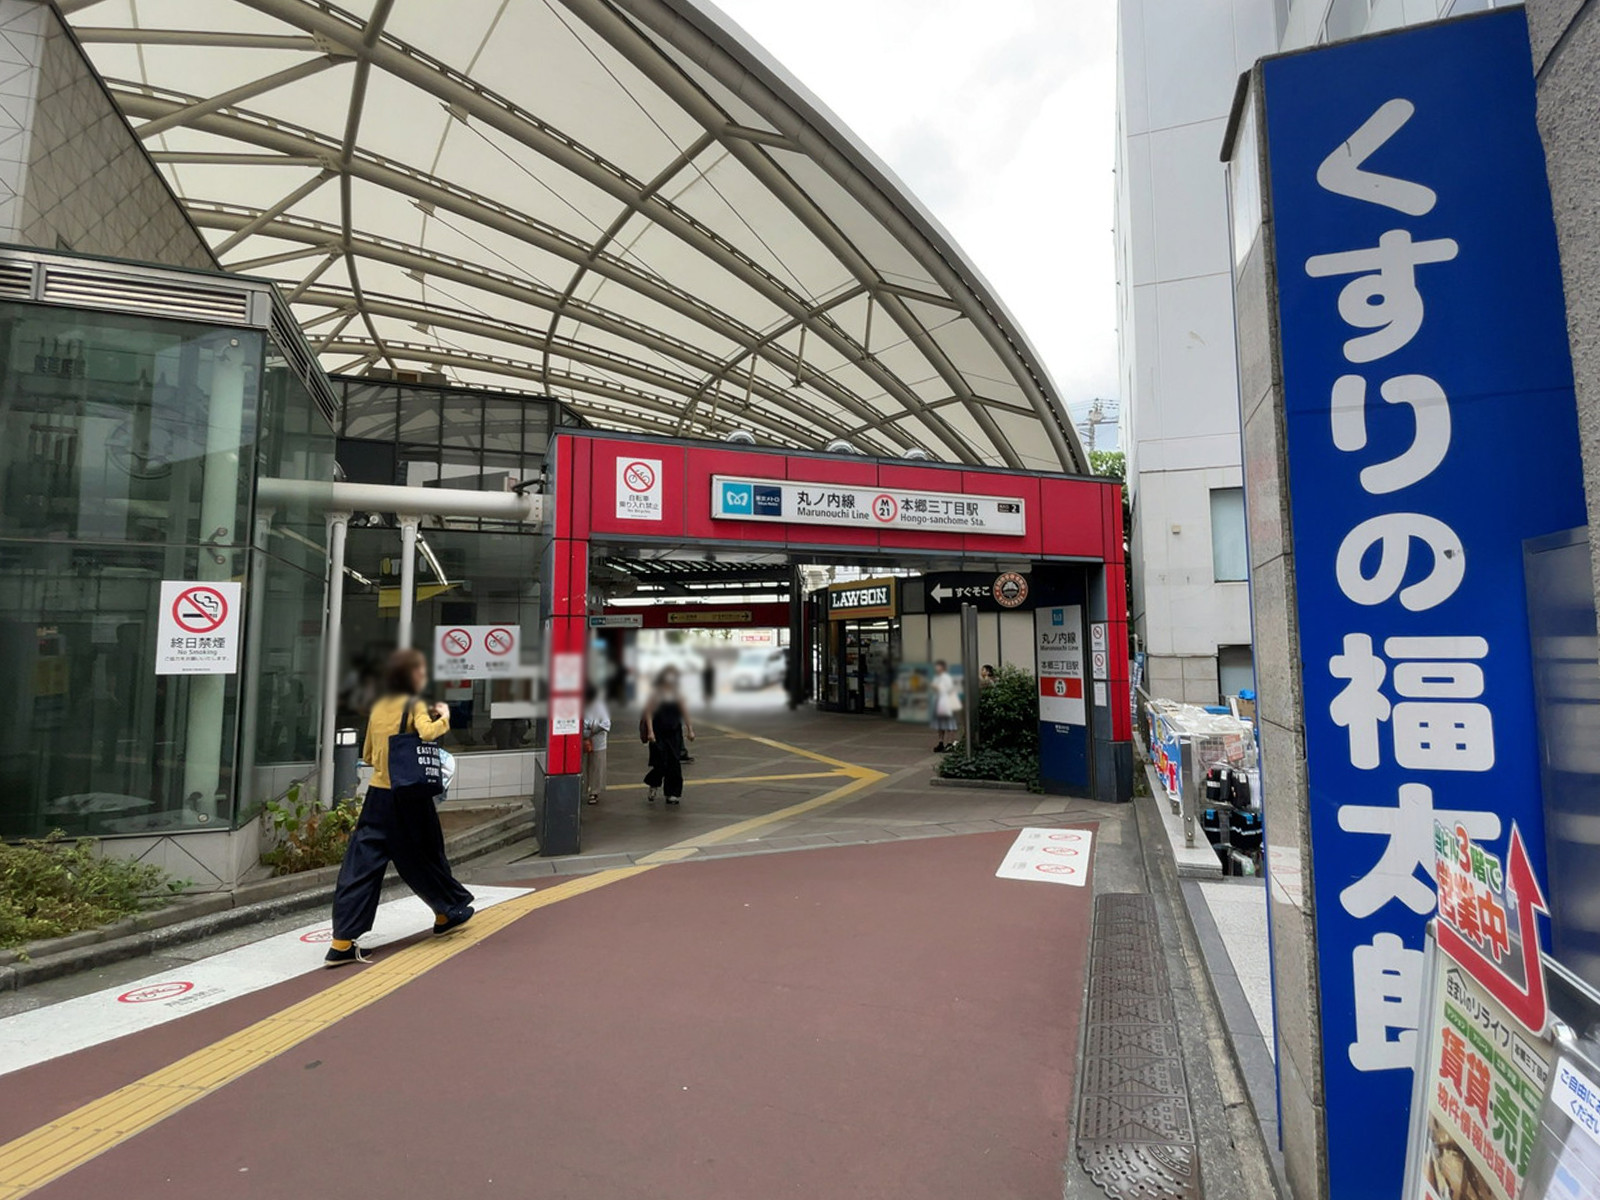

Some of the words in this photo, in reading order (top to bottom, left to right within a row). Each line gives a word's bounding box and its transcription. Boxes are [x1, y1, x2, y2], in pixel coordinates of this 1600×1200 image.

[797, 491, 855, 509] 丸ノ内線
[880, 499, 890, 507] M
[901, 498, 979, 516] 本郷三丁目駅
[797, 506, 849, 519] Marunouchi
[851, 508, 870, 520] Line
[879, 507, 891, 517] 21
[901, 513, 969, 525] Hongo-sanchome
[970, 517, 986, 527] Sta.
[832, 587, 888, 608] LAWSON
[955, 587, 991, 597] すぐそこ
[170, 637, 226, 649] 終日禁煙
[1041, 632, 1077, 645] 丸ノ内線
[1041, 660, 1080, 670] 本郷三丁目駅
[1436, 858, 1511, 963] 営業中
[1446, 974, 1511, 1047] 住まいのリライフ
